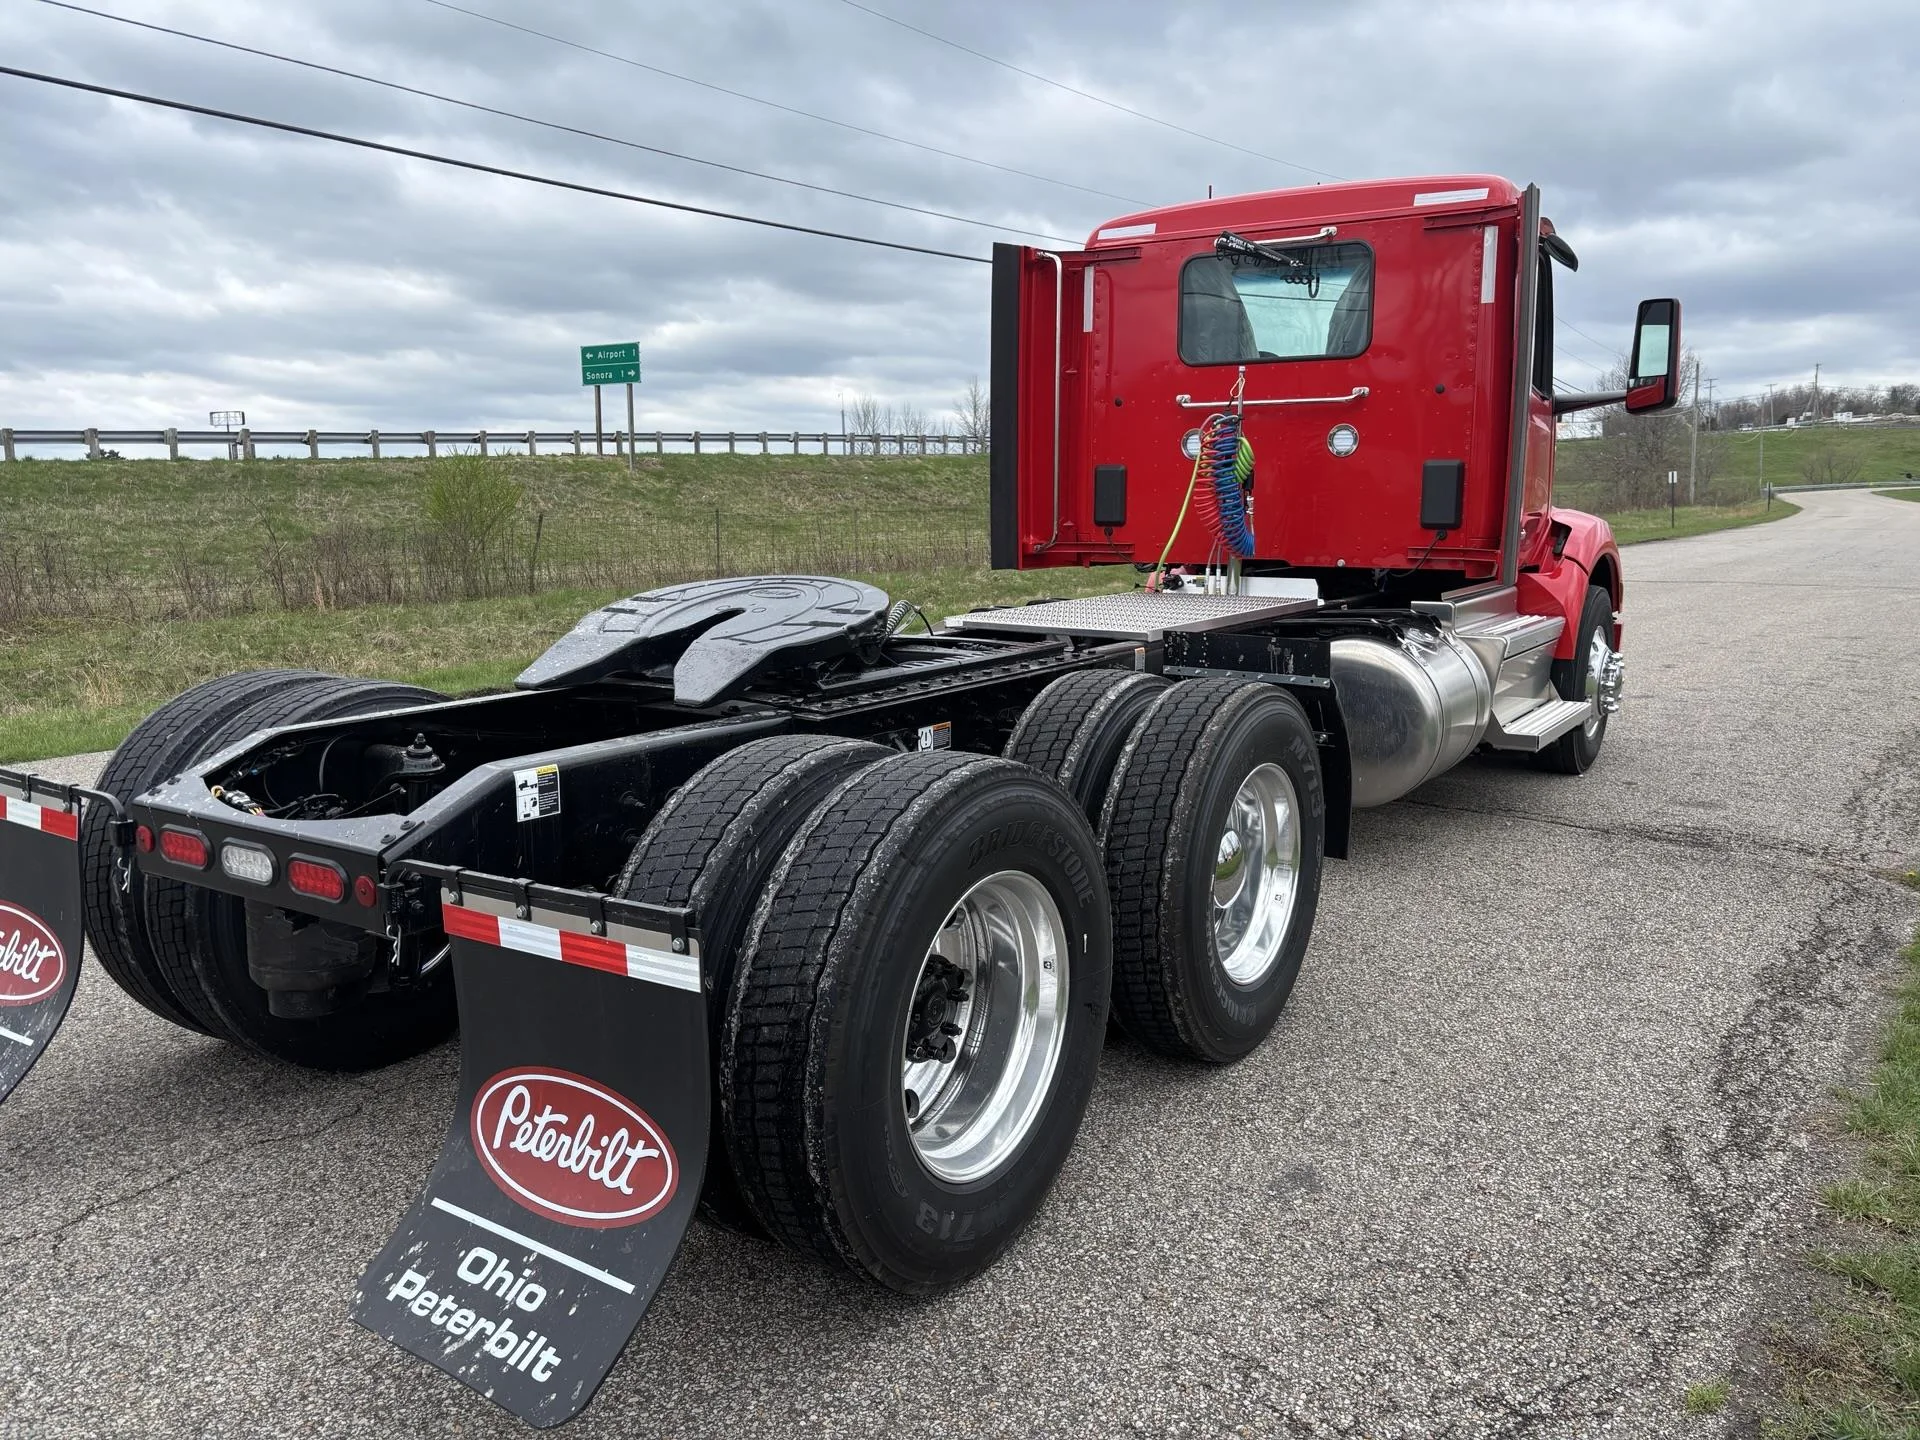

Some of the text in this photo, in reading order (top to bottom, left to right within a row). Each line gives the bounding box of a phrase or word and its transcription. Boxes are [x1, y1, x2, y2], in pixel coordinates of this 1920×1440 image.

[586, 371, 613, 380] Sonora
[597, 349, 626, 360] Airport
[968, 820, 1096, 908] BRIDGESTONE
[493, 1085, 660, 1195] Peterbilt
[457, 1247, 547, 1312] Ohio
[386, 1268, 562, 1383] Peterbilt
